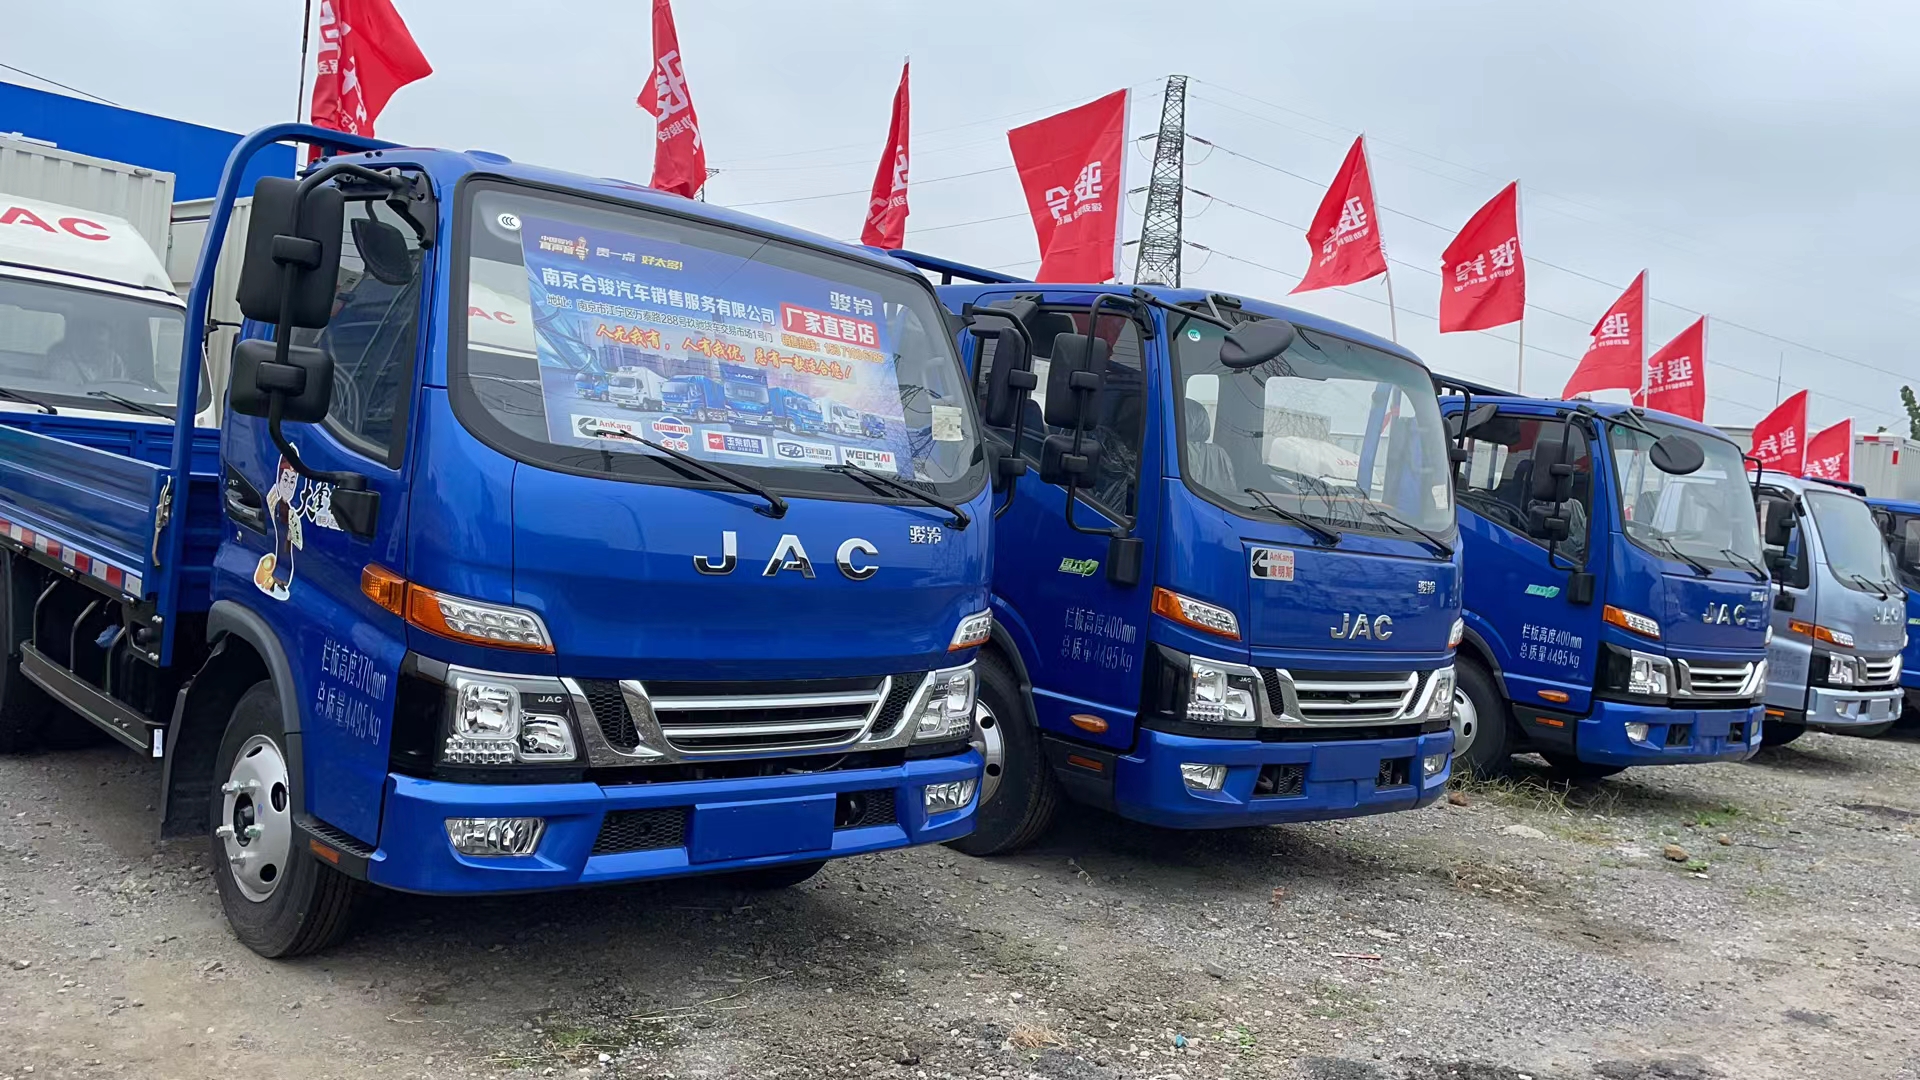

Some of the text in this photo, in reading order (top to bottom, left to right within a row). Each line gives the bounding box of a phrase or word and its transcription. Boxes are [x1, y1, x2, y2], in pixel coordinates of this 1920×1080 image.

[541, 267, 777, 326] 南京合骏汽车销售服务有限公司
[829, 290, 874, 317] 骏铃
[785, 306, 876, 345] 厂家直营店
[599, 420, 632, 431] AnKang
[845, 449, 890, 463] WEICHAI
[908, 525, 942, 544] 骏铃
[693, 530, 880, 581] JAC
[1269, 552, 1294, 564] AnKang
[1269, 565, 1293, 579] 康明斯
[1330, 612, 1394, 641] JAC
[1702, 602, 1747, 626] JAC
[1522, 622, 1583, 650] 栏板高度400mm
[321, 636, 387, 702] 栏板高度370mm
[537, 694, 563, 704] JAC
